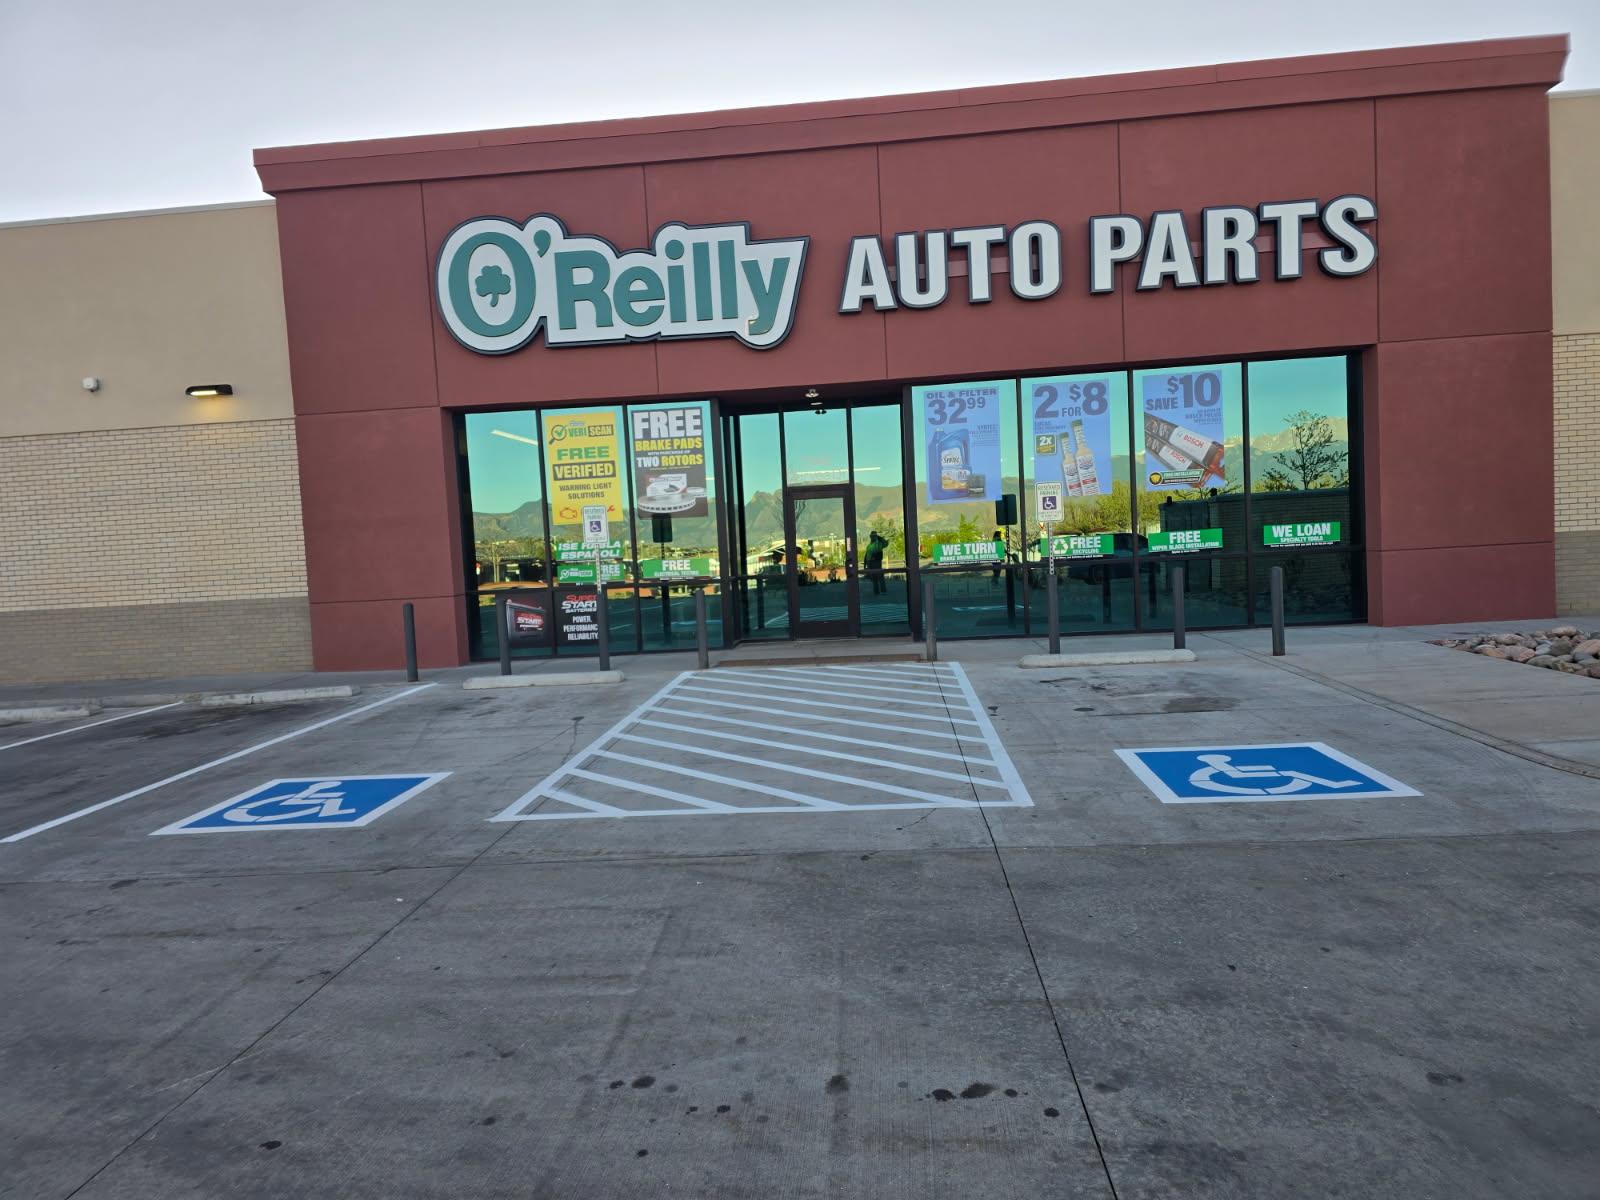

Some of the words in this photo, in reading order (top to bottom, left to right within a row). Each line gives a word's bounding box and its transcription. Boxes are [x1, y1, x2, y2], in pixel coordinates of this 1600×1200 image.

[448, 228, 791, 338] O'Reilly
[838, 219, 1063, 314] AUTO
[1089, 194, 1379, 295] PARTS
[926, 391, 946, 400] OIL
[948, 391, 956, 399] &
[958, 388, 997, 398] FILTER
[1145, 397, 1179, 411] SAVE
[1168, 372, 1221, 409] $10
[1034, 385, 1059, 418] 2
[1069, 382, 1108, 416] $8
[1062, 406, 1082, 417] FOR
[589, 425, 613, 437] SCAN
[633, 408, 703, 440] FREE
[635, 439, 672, 452] BRAKE
[673, 437, 703, 450] PADS
[1183, 434, 1205, 449] BOSCH
[556, 446, 610, 461] FREE
[636, 456, 660, 468] TWO
[661, 454, 704, 467] ROTORS
[553, 463, 614, 479] VERIFIED
[559, 484, 592, 492] WARNING
[592, 482, 612, 490] LIGHT
[568, 491, 605, 500] SOLUTIONS
[1169, 530, 1201, 544] FREE
[1272, 525, 1293, 538] WE
[1296, 523, 1331, 536] LOAN
[941, 544, 961, 556] WE
[963, 541, 997, 554] TURN
[1069, 536, 1102, 549] FREE
[600, 564, 621, 575] REE
[661, 559, 691, 571] FREE
[563, 623, 599, 633] PERFORMANC
